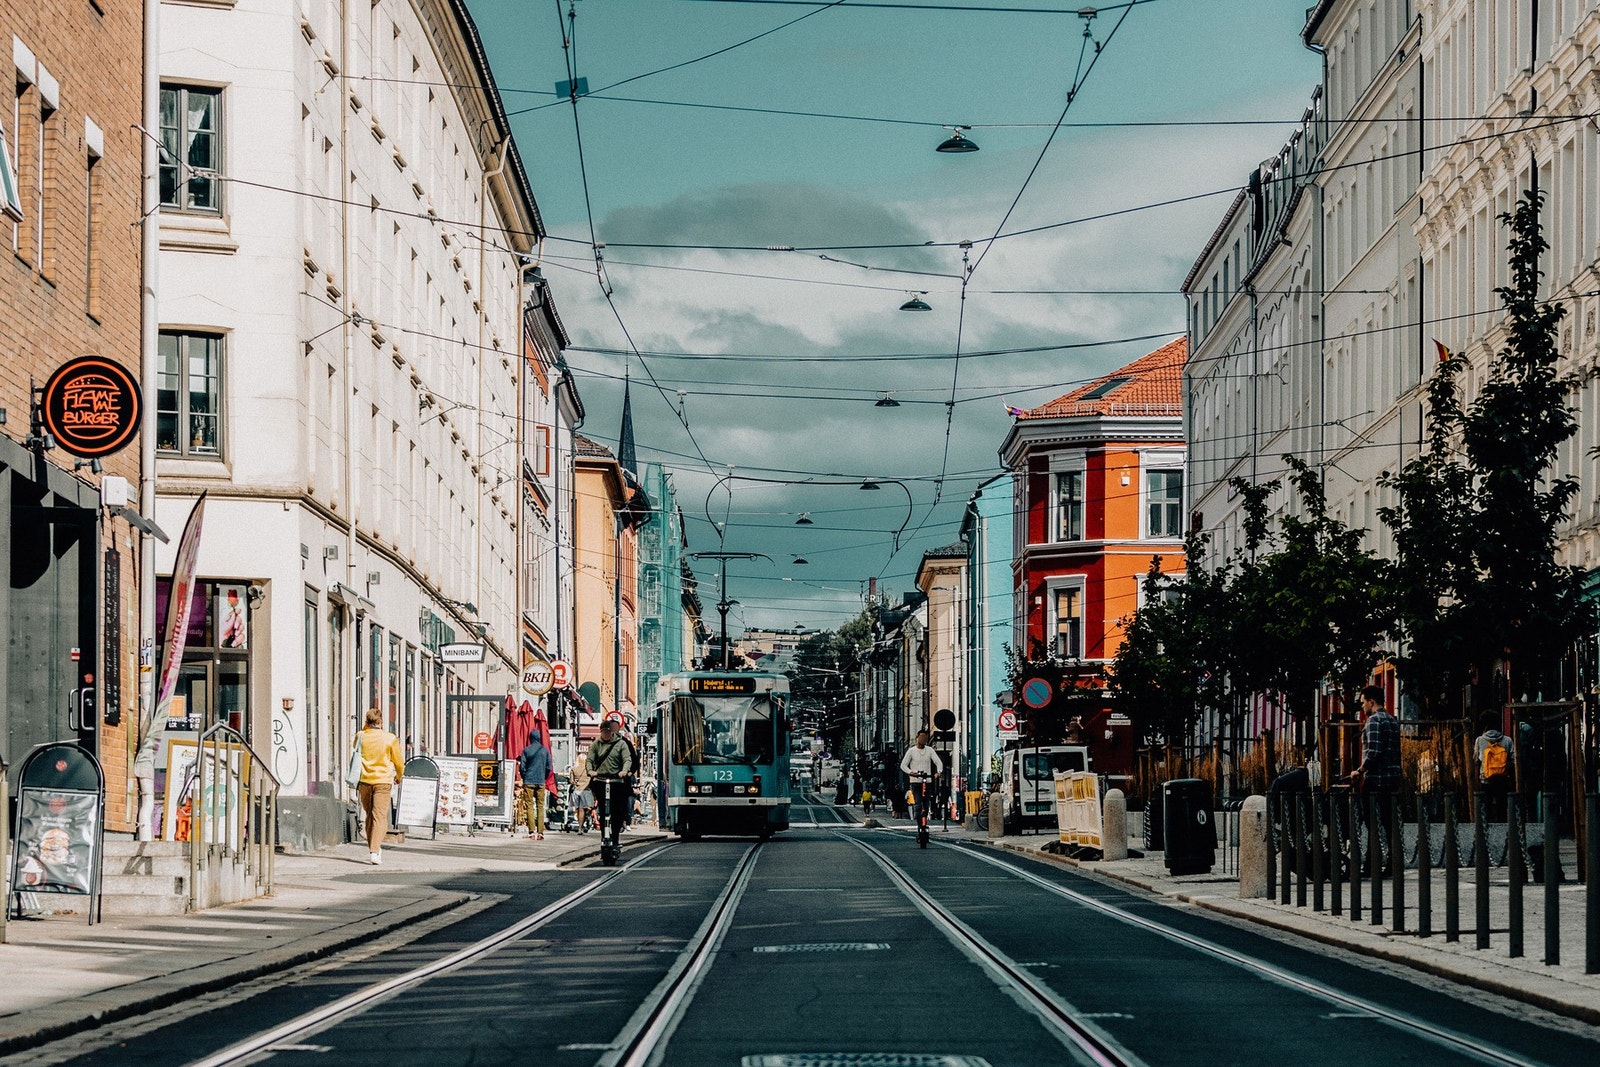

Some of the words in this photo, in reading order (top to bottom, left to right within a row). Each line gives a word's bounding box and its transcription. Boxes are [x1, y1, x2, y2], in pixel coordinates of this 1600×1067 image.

[61, 410, 120, 425] BURGER
[444, 648, 480, 657] MINIBANK
[522, 672, 552, 683] BKH
[712, 769, 733, 781] 123
